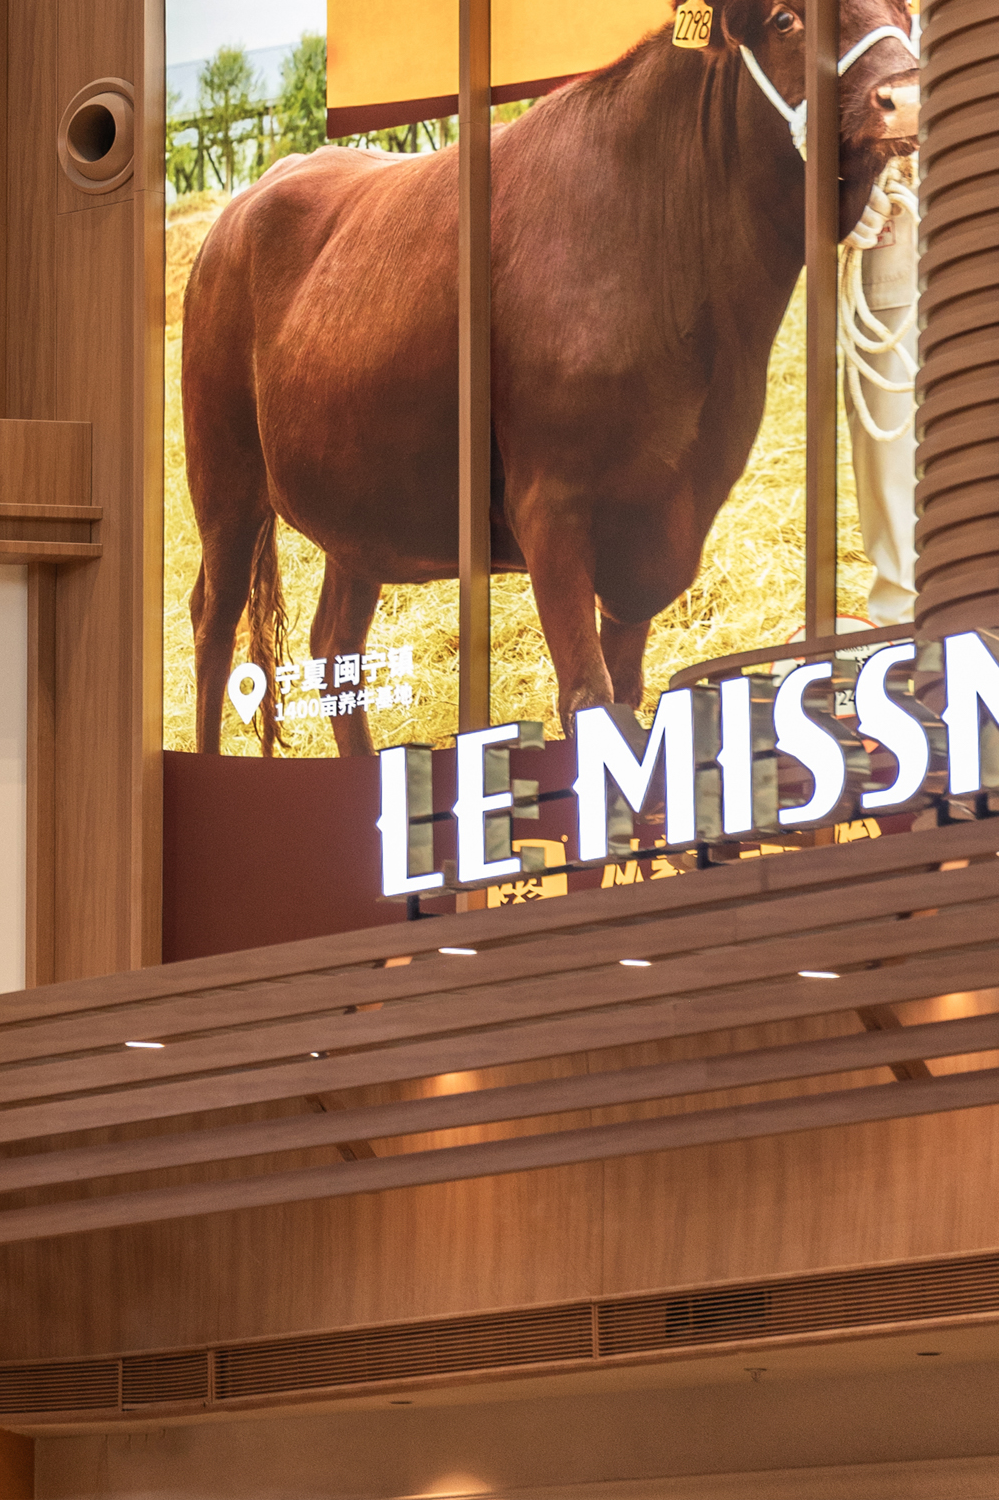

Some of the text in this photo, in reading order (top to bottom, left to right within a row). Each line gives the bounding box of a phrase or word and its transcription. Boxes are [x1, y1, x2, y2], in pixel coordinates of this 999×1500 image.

[675, 10, 712, 41] 2298
[275, 658, 328, 695] 宁夏
[274, 682, 413, 722] 1400亩养牛基地
[375, 724, 521, 897] LE
